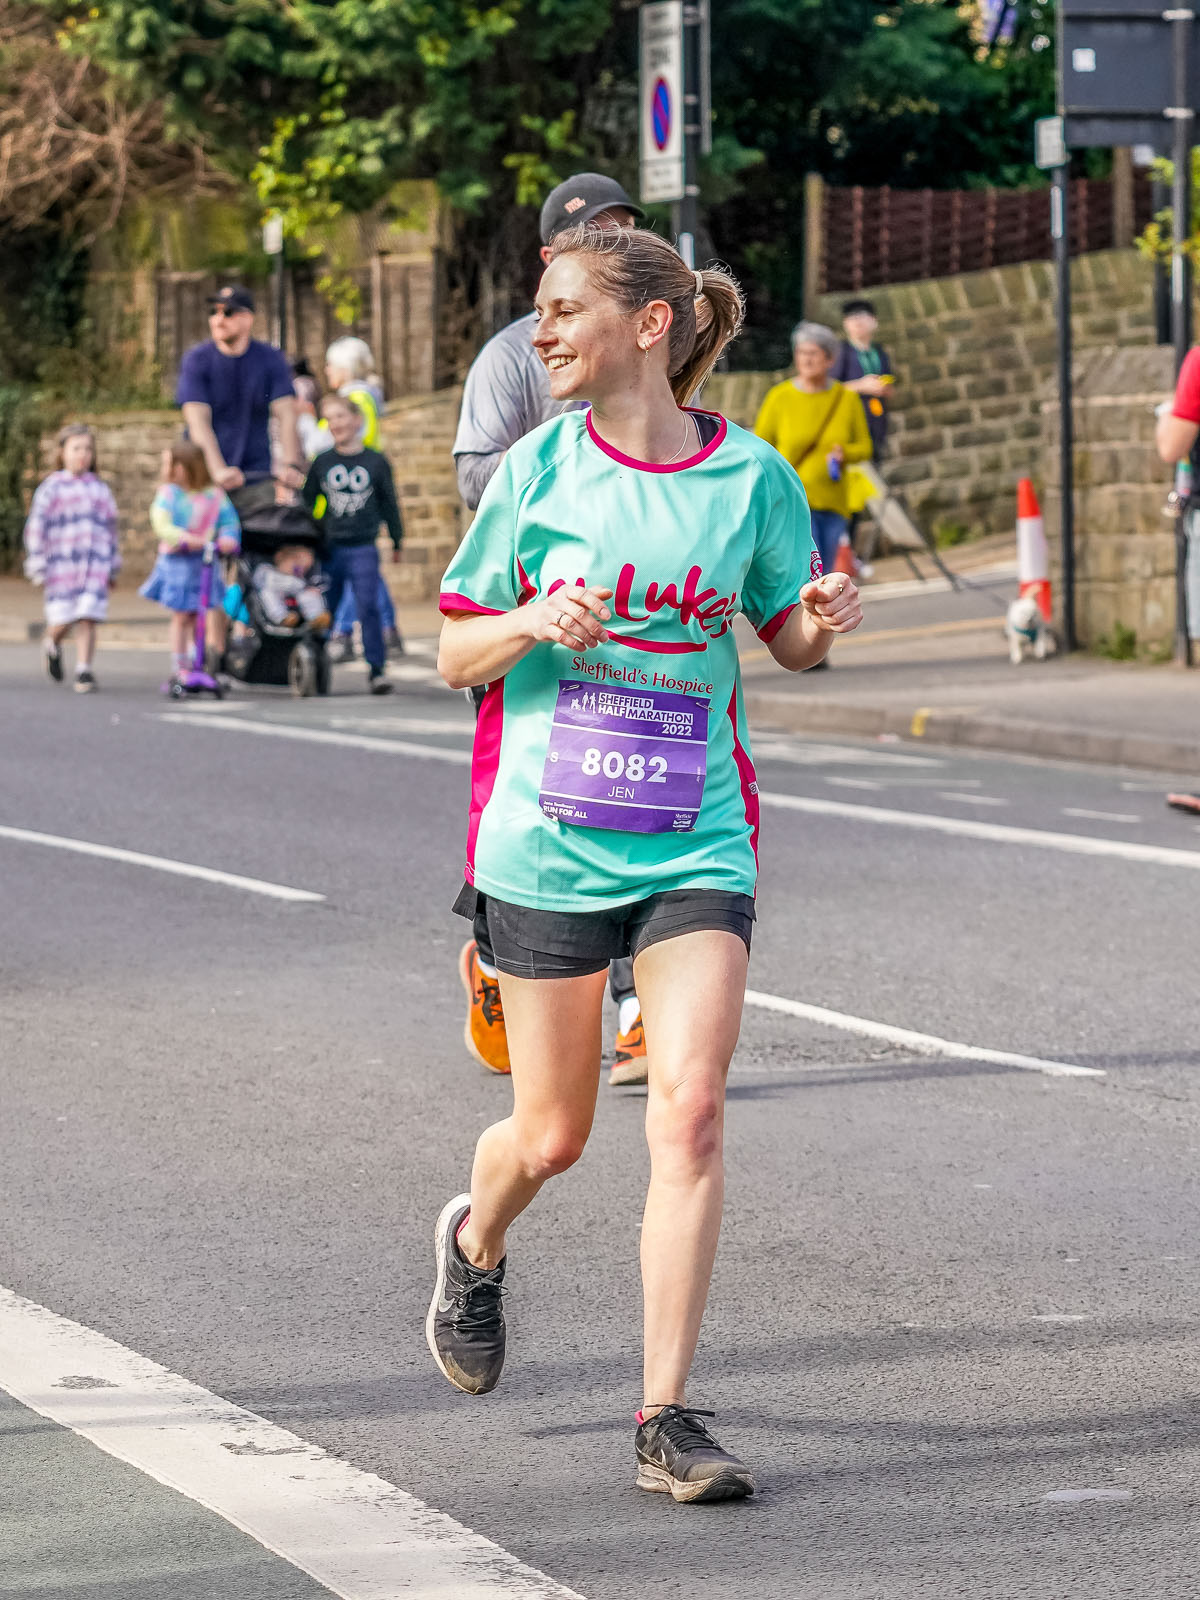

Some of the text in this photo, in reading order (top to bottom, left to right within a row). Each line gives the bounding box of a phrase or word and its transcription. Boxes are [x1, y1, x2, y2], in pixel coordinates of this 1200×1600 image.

[571, 656, 713, 695] Sheffield's Hospice
[599, 693, 652, 709] SHEFFIELD
[598, 704, 692, 724] HALF MARATHON
[661, 723, 692, 737] 2022
[549, 751, 560, 763] S
[580, 748, 668, 783] 8082
[607, 786, 635, 800] JEN
[543, 805, 588, 819] RUN FOR ALL
